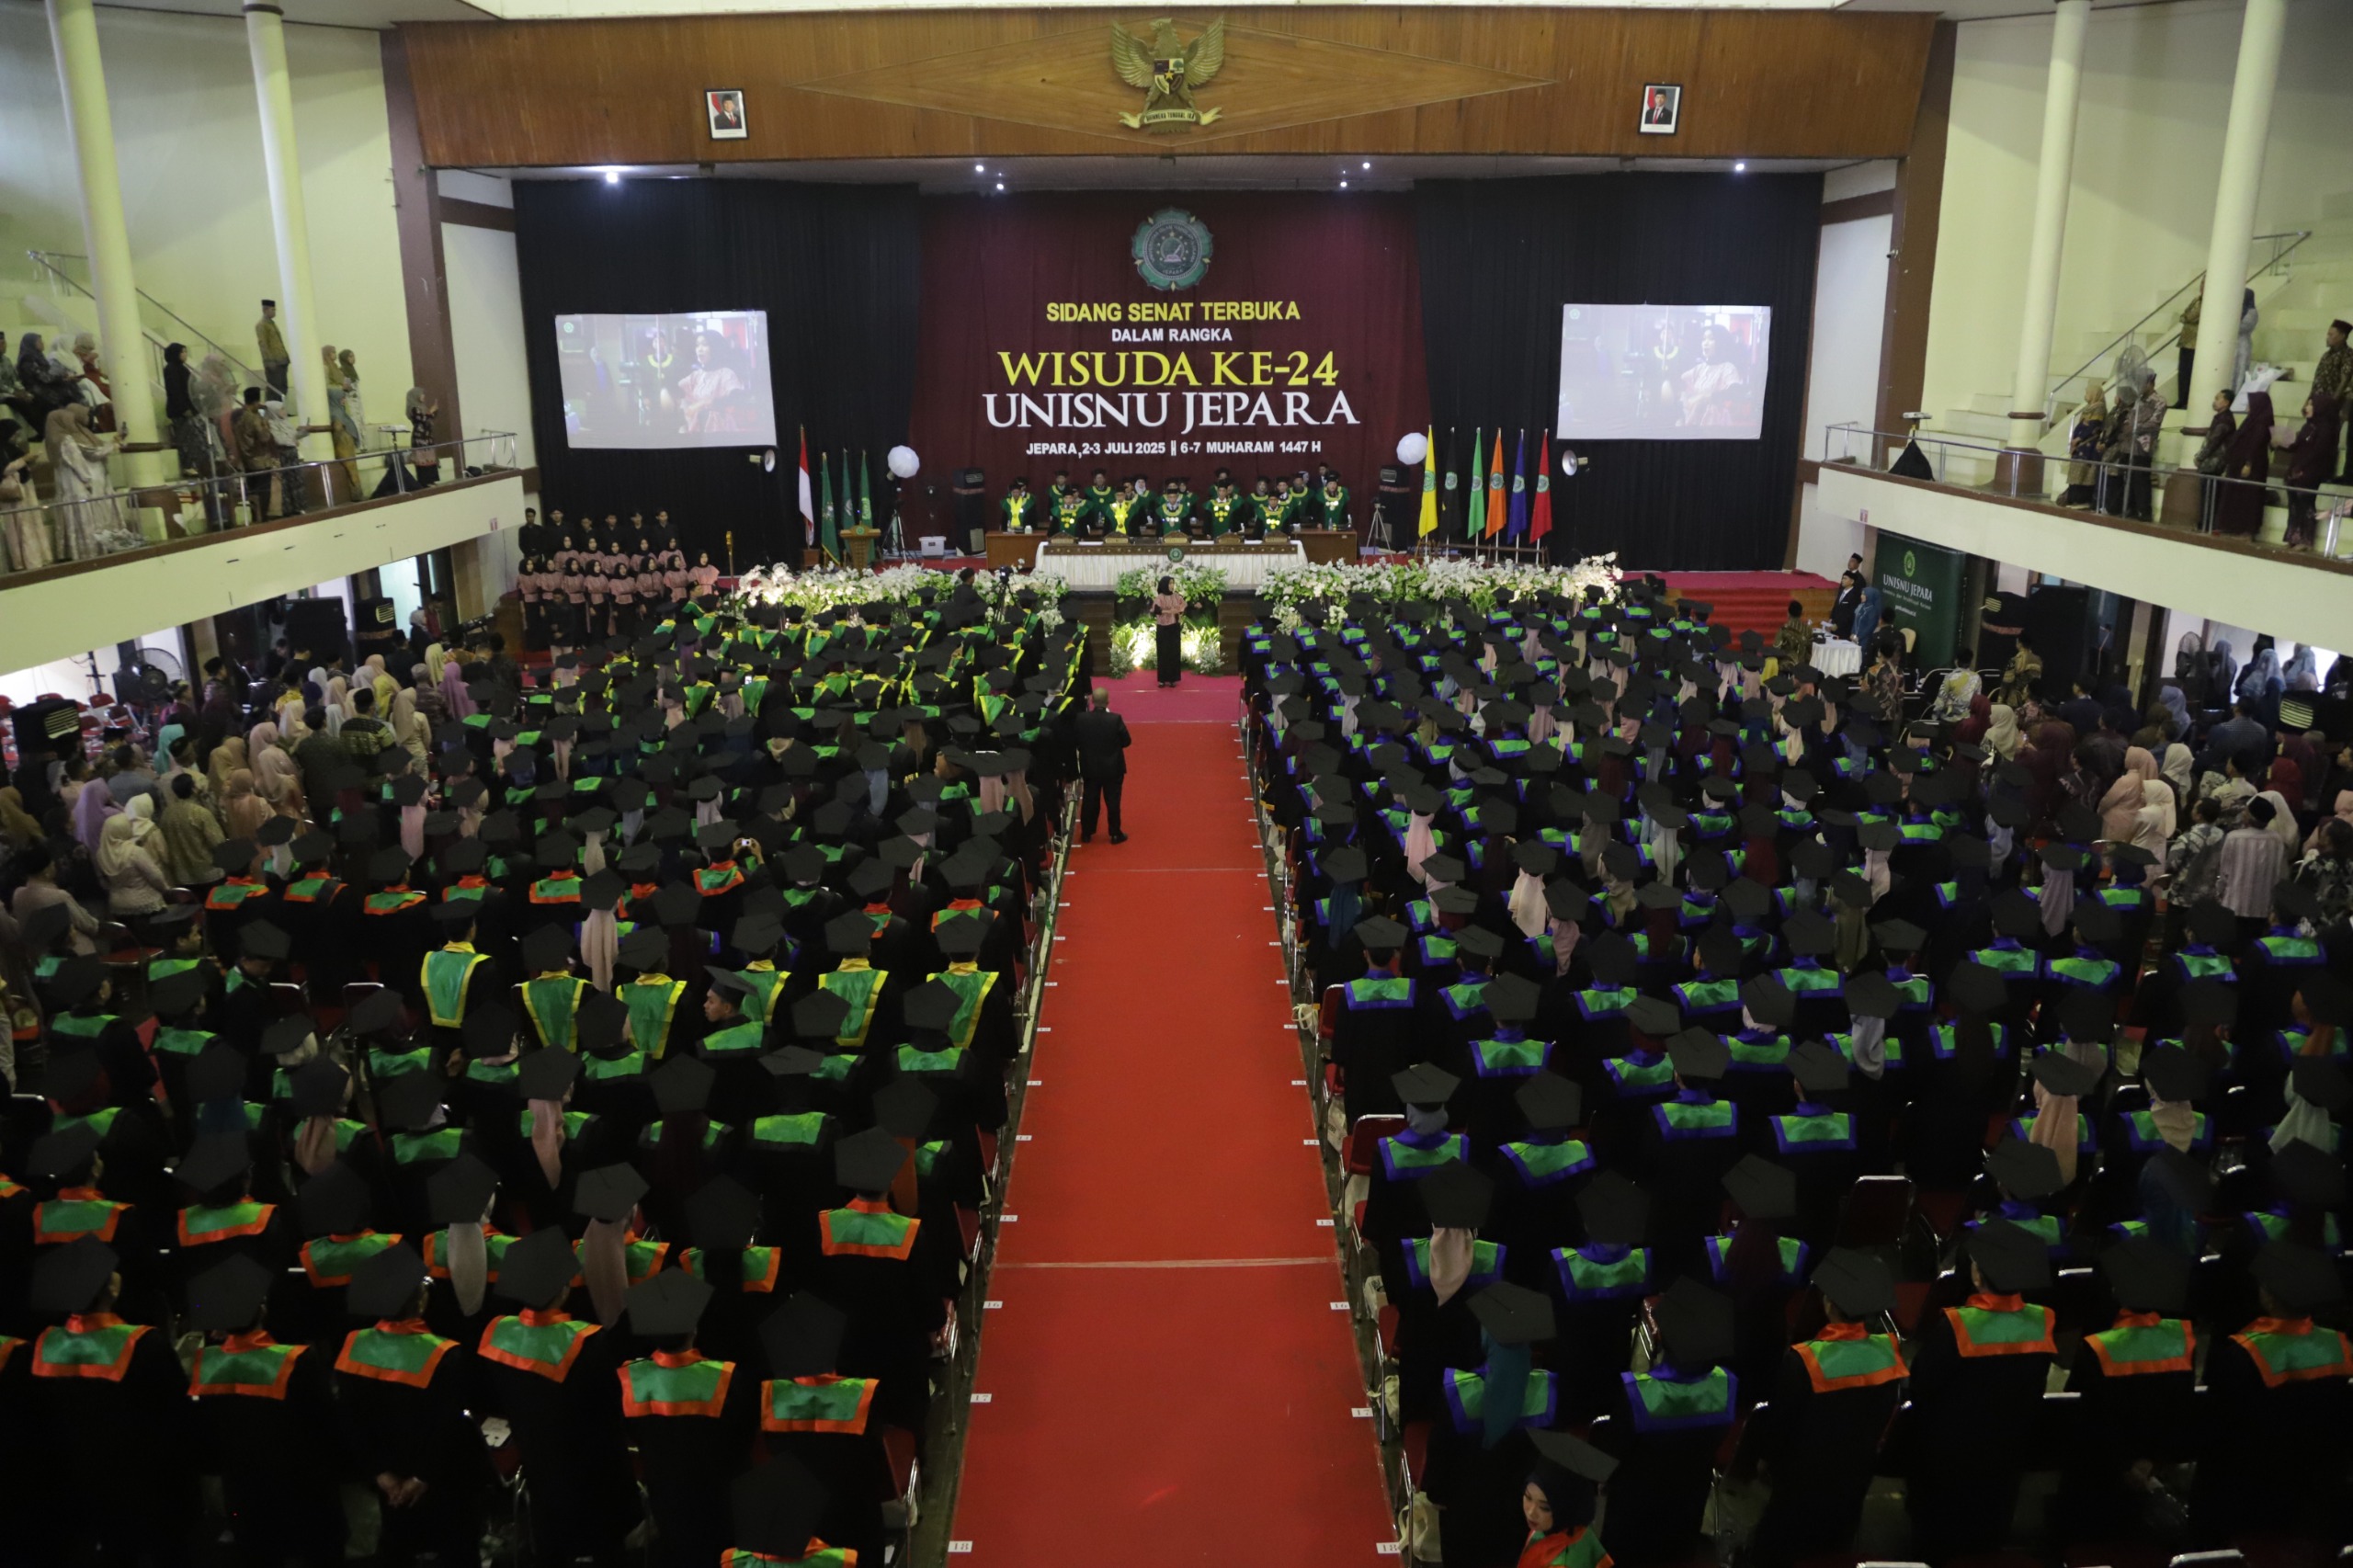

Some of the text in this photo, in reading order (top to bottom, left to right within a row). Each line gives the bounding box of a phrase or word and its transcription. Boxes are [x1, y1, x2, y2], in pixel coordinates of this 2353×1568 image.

[1046, 301, 1301, 323] SIDANG SENAT TERBUKA
[1111, 327, 1233, 343] DALAM RANGKA
[997, 350, 1339, 386] WISUDA KE-24
[983, 390, 1360, 435] UNISNU JEPARA
[1104, 442, 1133, 454] JULI
[1135, 442, 1165, 454] 2025
[1180, 442, 1201, 454] 6-7
[1206, 441, 1274, 453] MUHARAM
[1279, 441, 1309, 453] 1447
[1312, 441, 1321, 452] H
[1882, 574, 1910, 593] UNISNU
[1910, 584, 1933, 602] JEPARA
